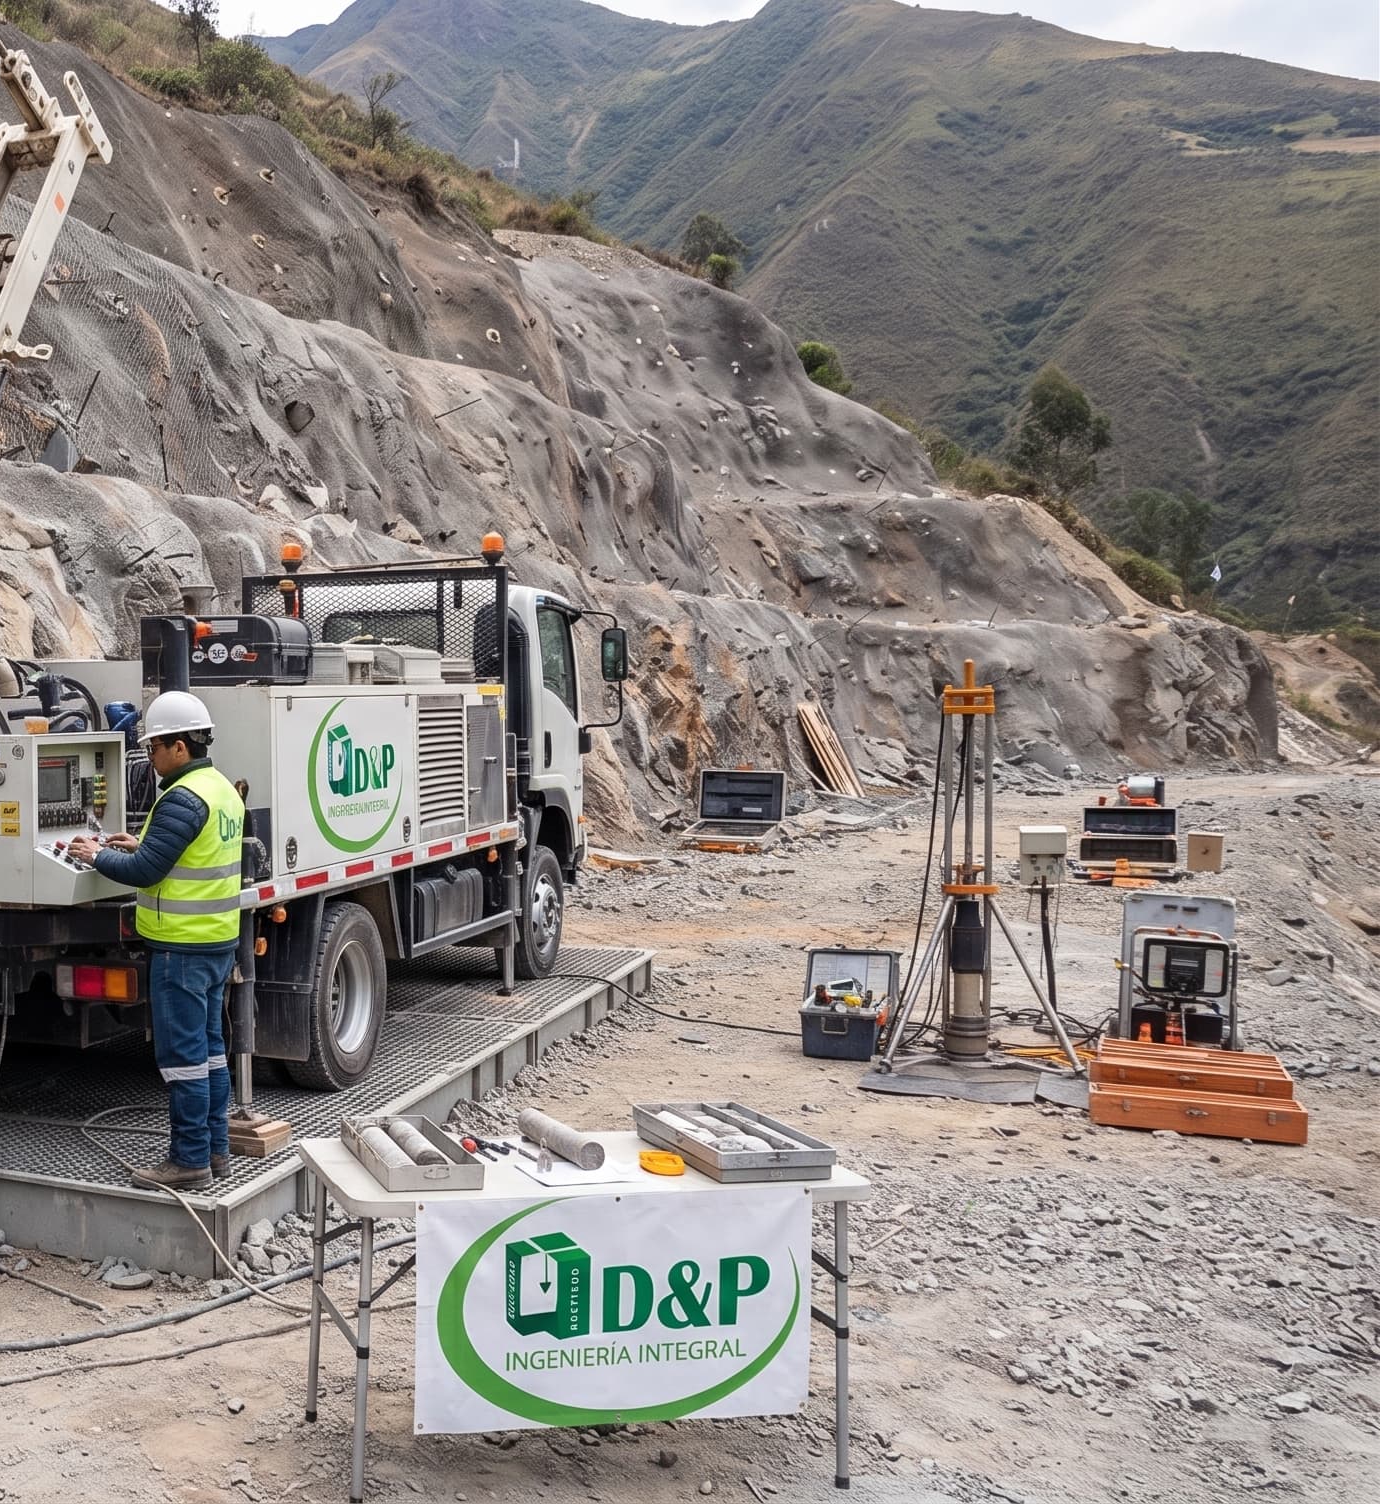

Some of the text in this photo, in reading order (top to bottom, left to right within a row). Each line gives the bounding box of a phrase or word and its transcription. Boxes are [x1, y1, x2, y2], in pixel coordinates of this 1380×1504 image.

[354, 743, 395, 794] D&P
[602, 1255, 770, 1333] D&P
[506, 1338, 747, 1371] INGENIERÍA INTEGRAL
